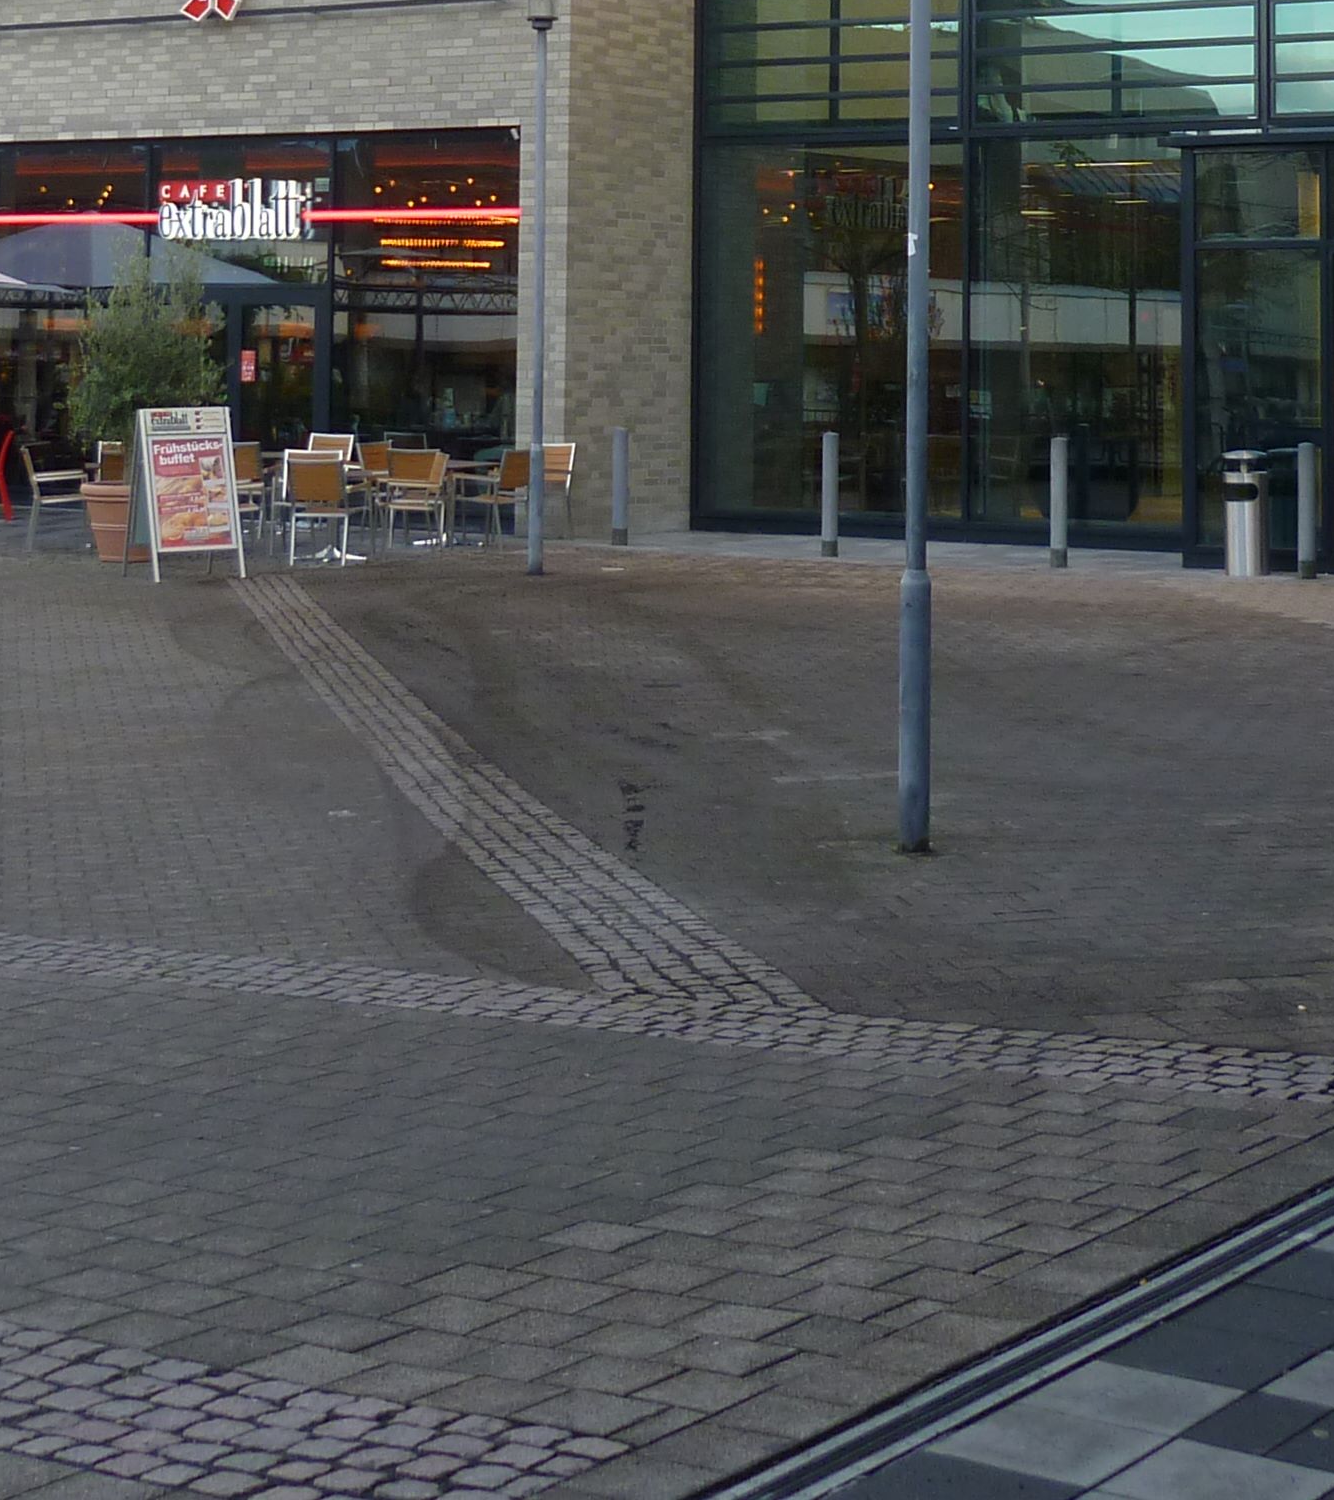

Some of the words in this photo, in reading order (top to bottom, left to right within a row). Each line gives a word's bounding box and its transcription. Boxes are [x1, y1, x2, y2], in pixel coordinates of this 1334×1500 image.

[161, 184, 226, 199] CAFE
[158, 177, 301, 240] extrablatt
[153, 440, 223, 456] Frühstücks-
[159, 453, 196, 466] buffet
